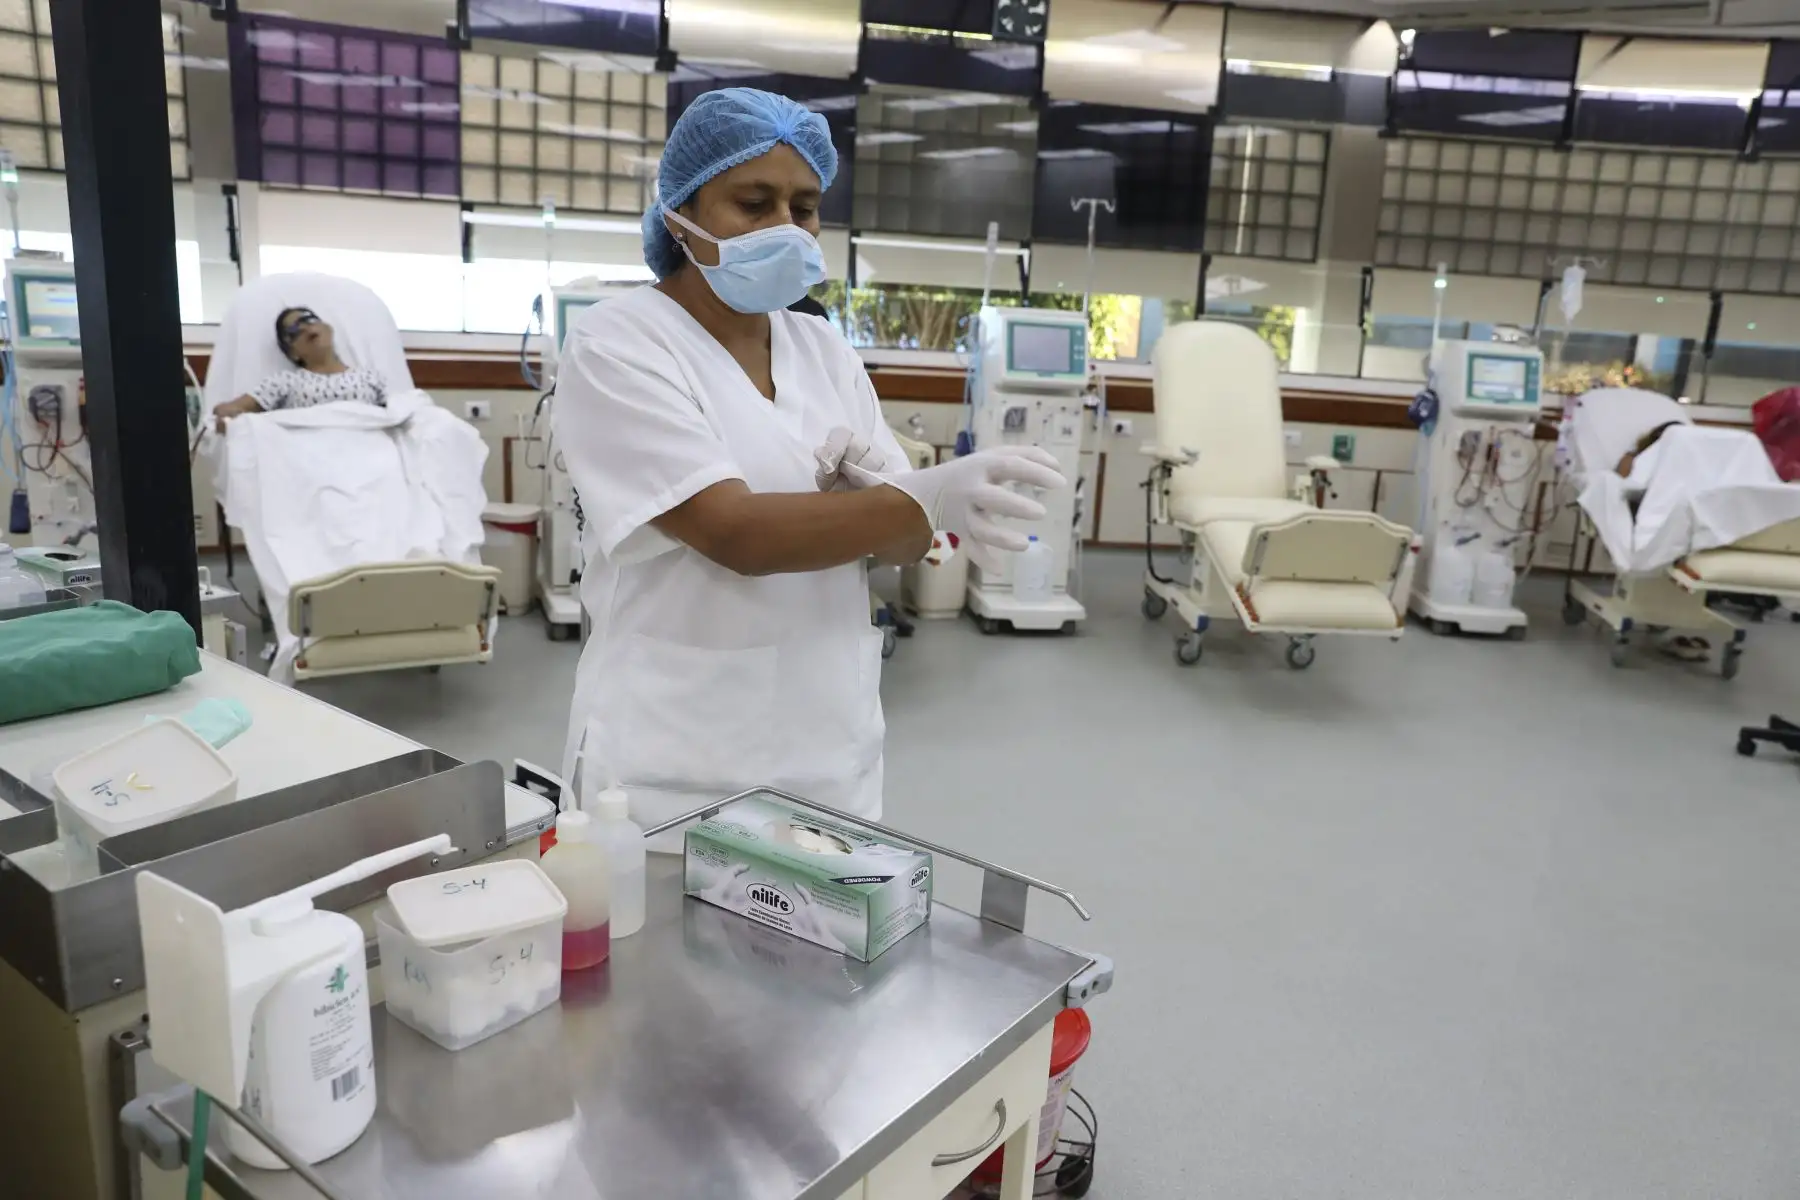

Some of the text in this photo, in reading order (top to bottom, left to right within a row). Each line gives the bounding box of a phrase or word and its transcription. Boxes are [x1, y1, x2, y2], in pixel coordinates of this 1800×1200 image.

[911, 869, 928, 886] nilife
[443, 878, 486, 895] S-4
[751, 887, 789, 912] nilife
